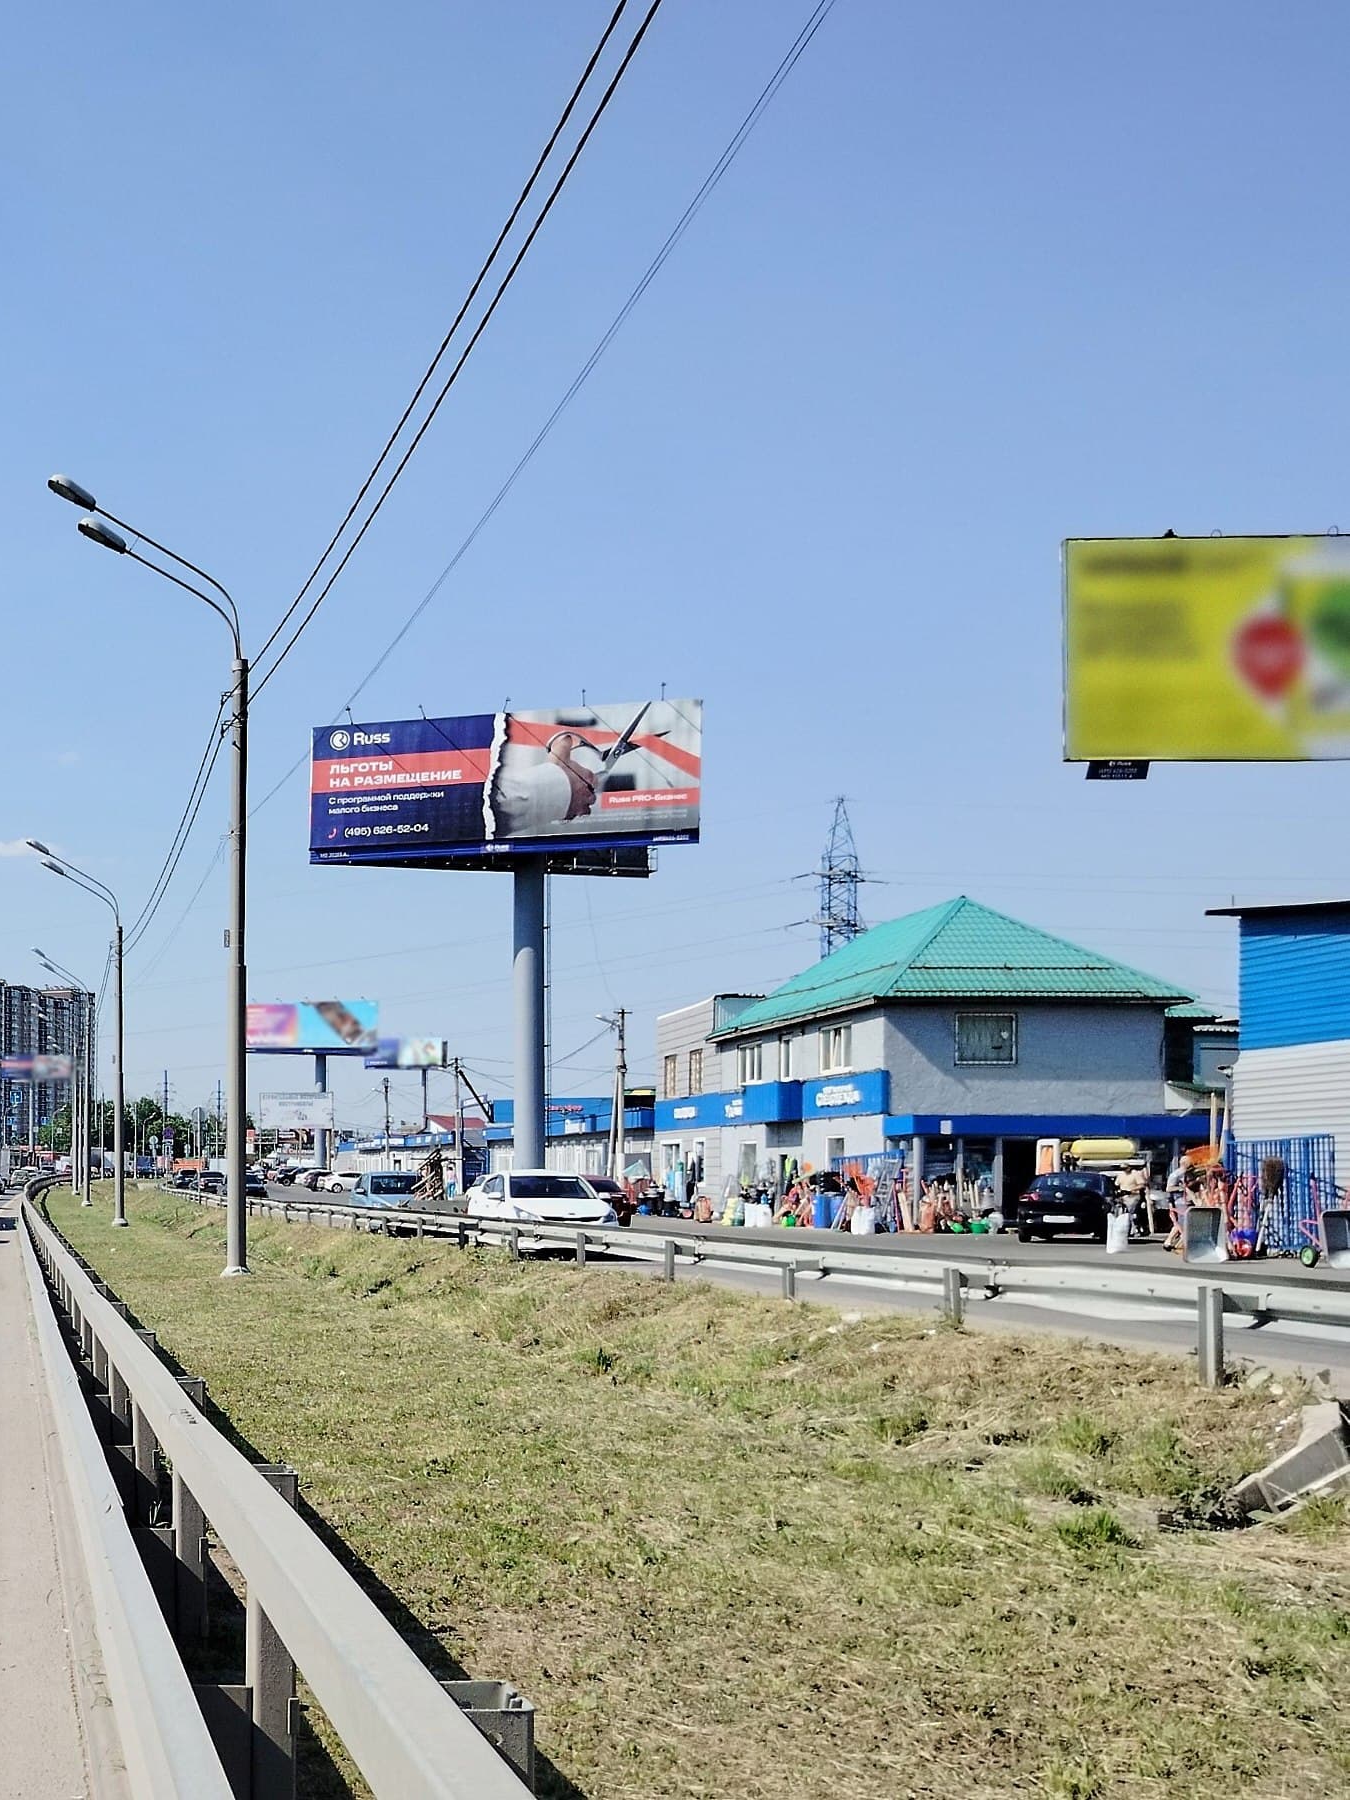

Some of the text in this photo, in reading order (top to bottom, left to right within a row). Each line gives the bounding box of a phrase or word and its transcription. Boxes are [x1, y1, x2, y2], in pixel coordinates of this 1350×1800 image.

[353, 732, 391, 746] Russ
[329, 761, 393, 775] ЛЬГОТЫ
[329, 770, 462, 788] НА РАЗМЕЩЕНИЕ
[337, 793, 392, 806] программой
[328, 806, 361, 815] малого
[344, 827, 372, 838] (495)
